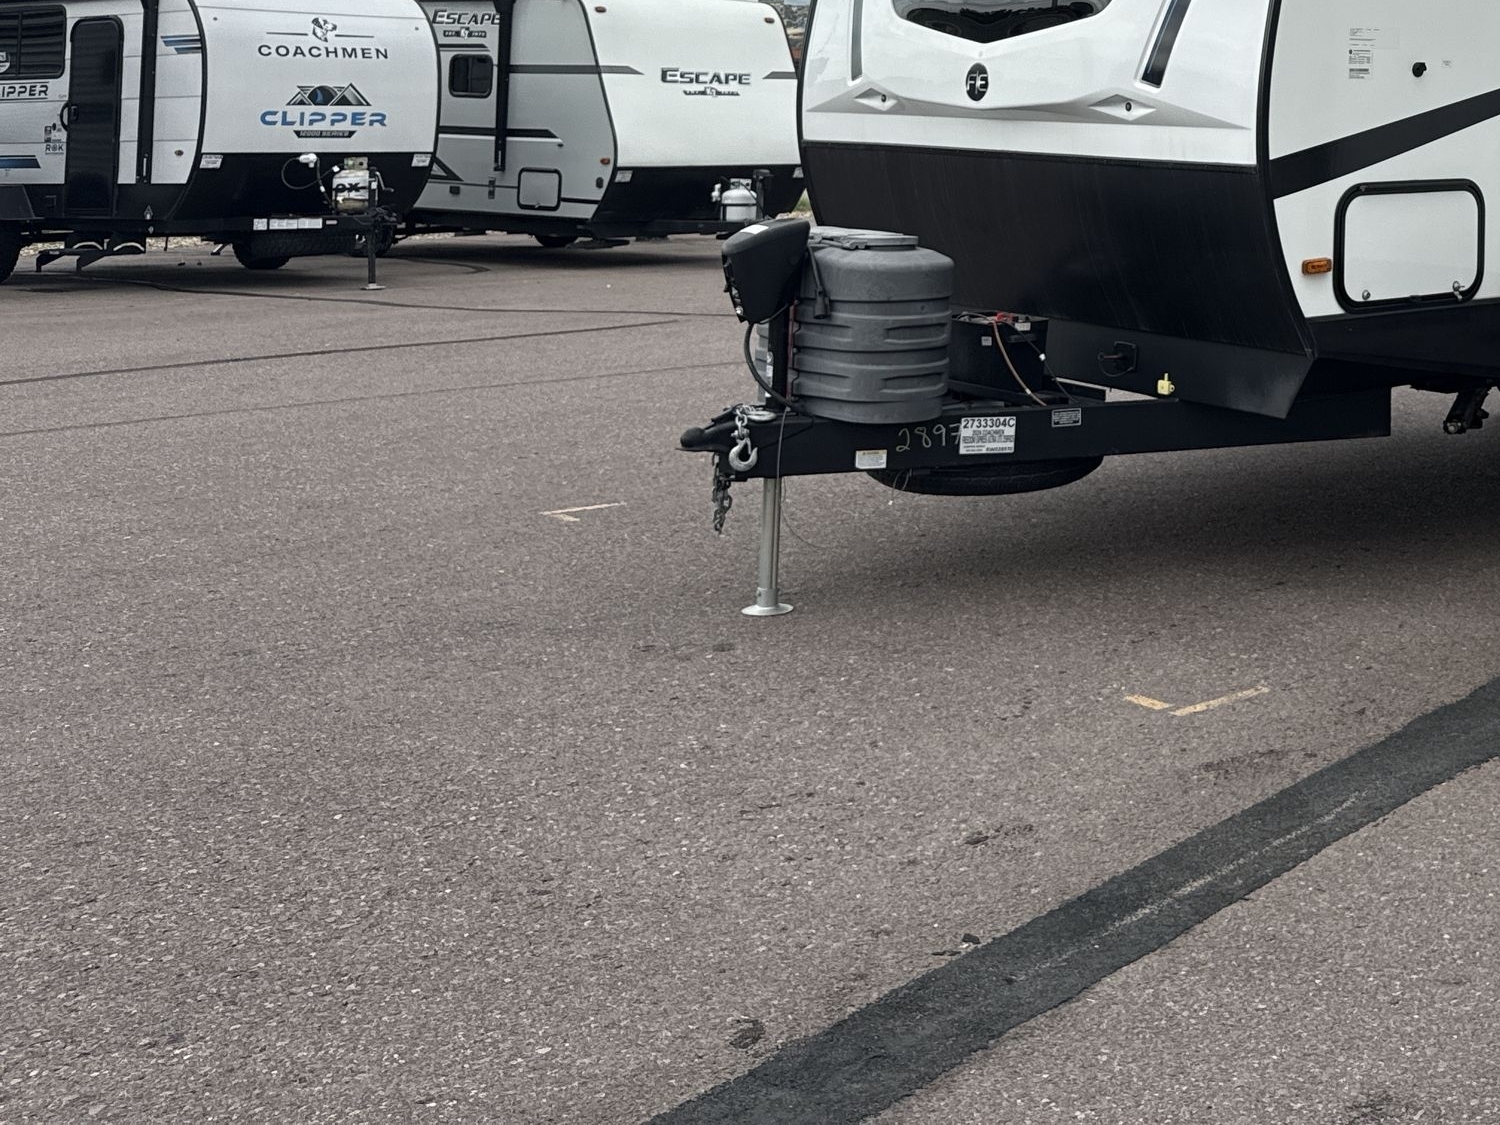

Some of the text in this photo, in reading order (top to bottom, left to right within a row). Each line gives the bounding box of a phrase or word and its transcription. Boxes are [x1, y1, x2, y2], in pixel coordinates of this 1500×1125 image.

[432, 8, 501, 26] ESCAPE
[257, 44, 389, 59] COACHMEN
[660, 67, 752, 85] ESCAPE
[0, 84, 49, 98] IPPER
[260, 110, 387, 128] CLIPPER
[962, 417, 1016, 429] 2733304C
